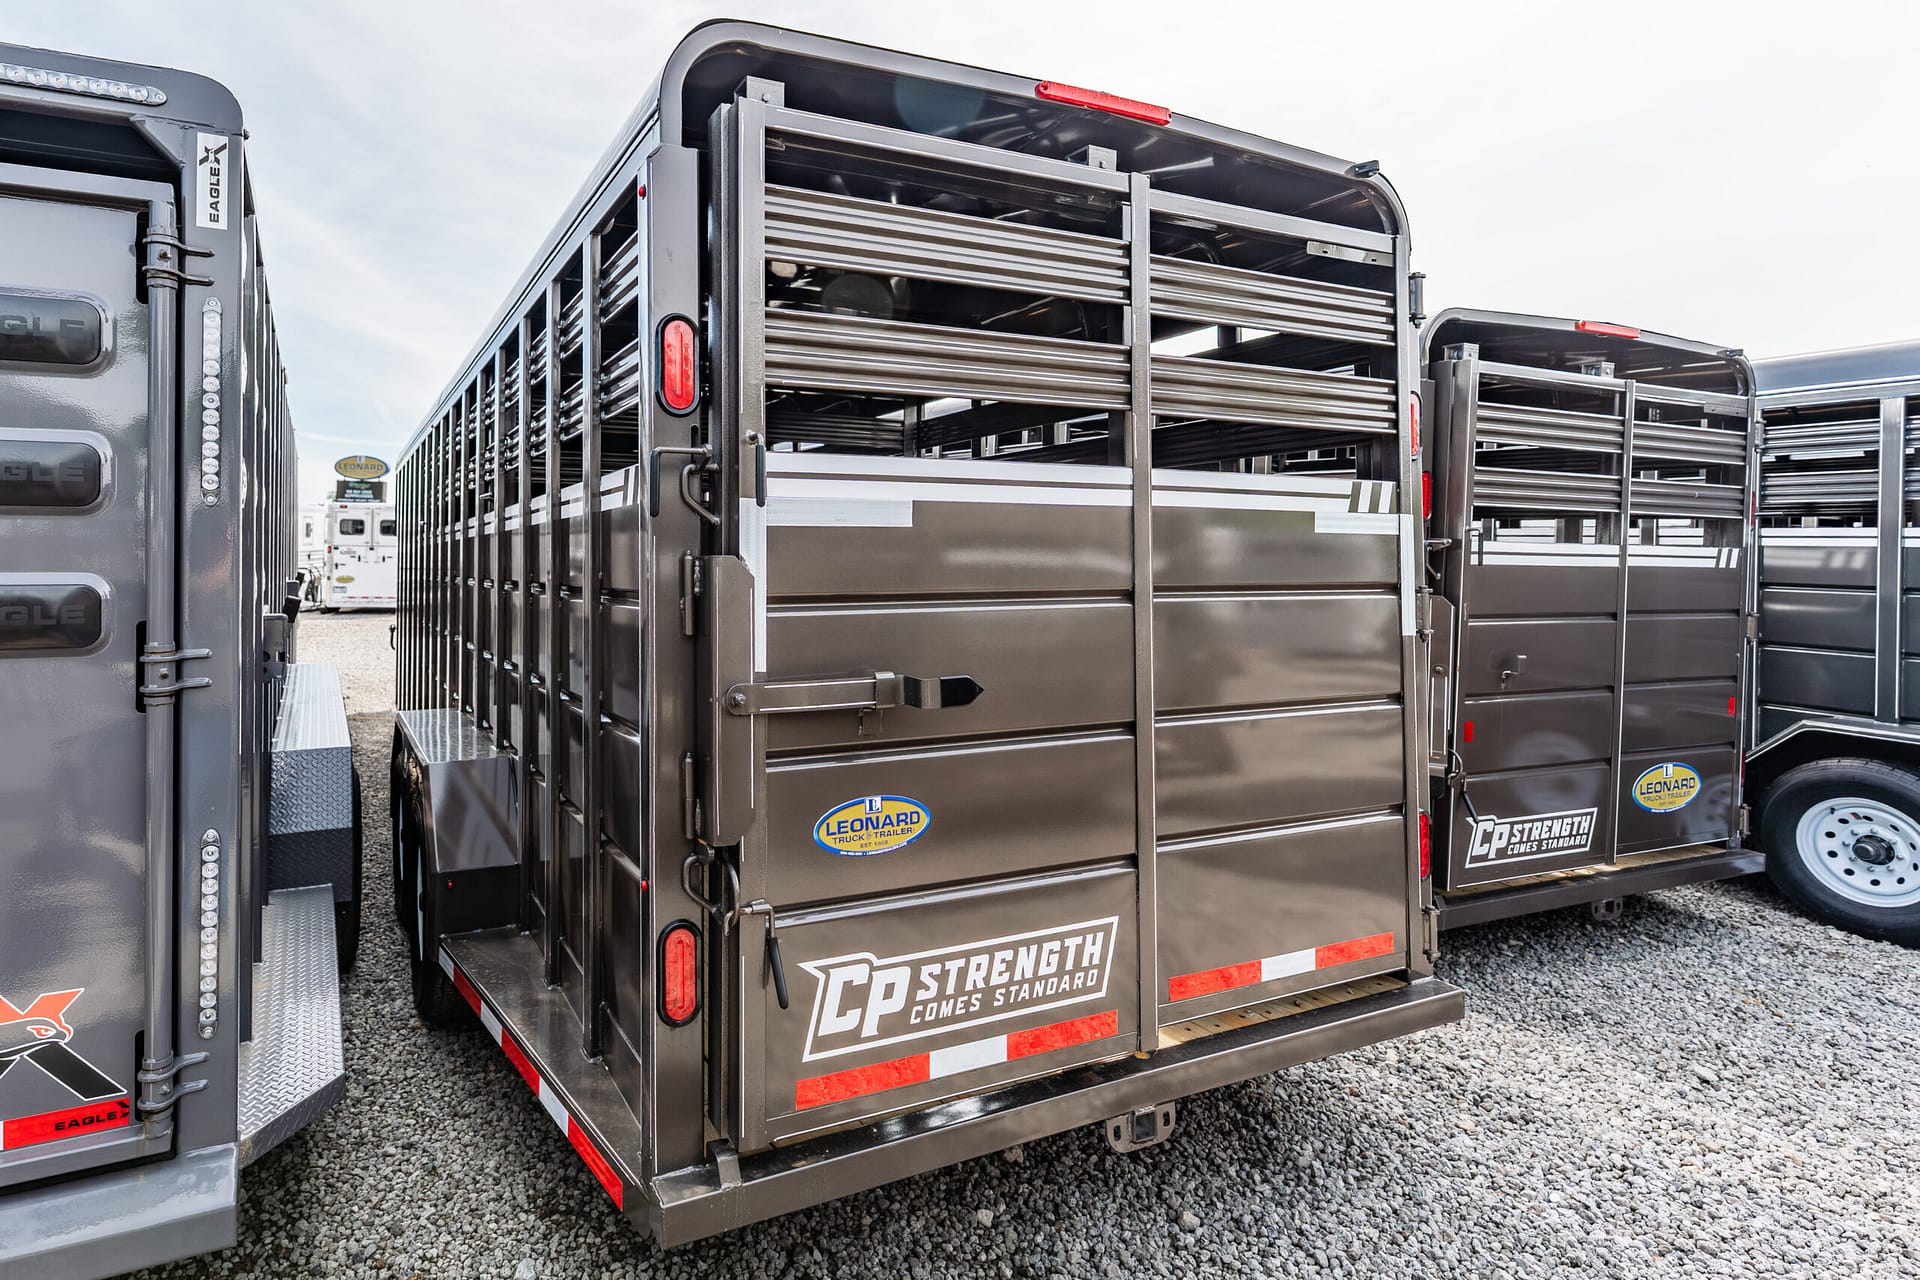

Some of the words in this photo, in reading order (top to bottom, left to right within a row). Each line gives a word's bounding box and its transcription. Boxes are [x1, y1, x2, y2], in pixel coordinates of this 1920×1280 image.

[209, 166, 220, 223] EAGLE
[338, 463, 384, 471] LEONARD
[1640, 777, 1696, 796] LEONARD
[825, 810, 921, 837] LEONARD
[832, 833, 865, 845] TRUCK
[873, 827, 913, 839] TRAILER
[1510, 815, 1592, 843] STRENGTH
[1472, 821, 1511, 859] CP
[1507, 841, 1539, 855] COMES
[1541, 834, 1588, 850] STANDARD
[915, 931, 1105, 1001] STRENGTH
[818, 963, 912, 1038] CP
[910, 992, 981, 1024] COMES
[993, 968, 1099, 1007] STANDARD
[55, 1111, 117, 1131] EAGLE
